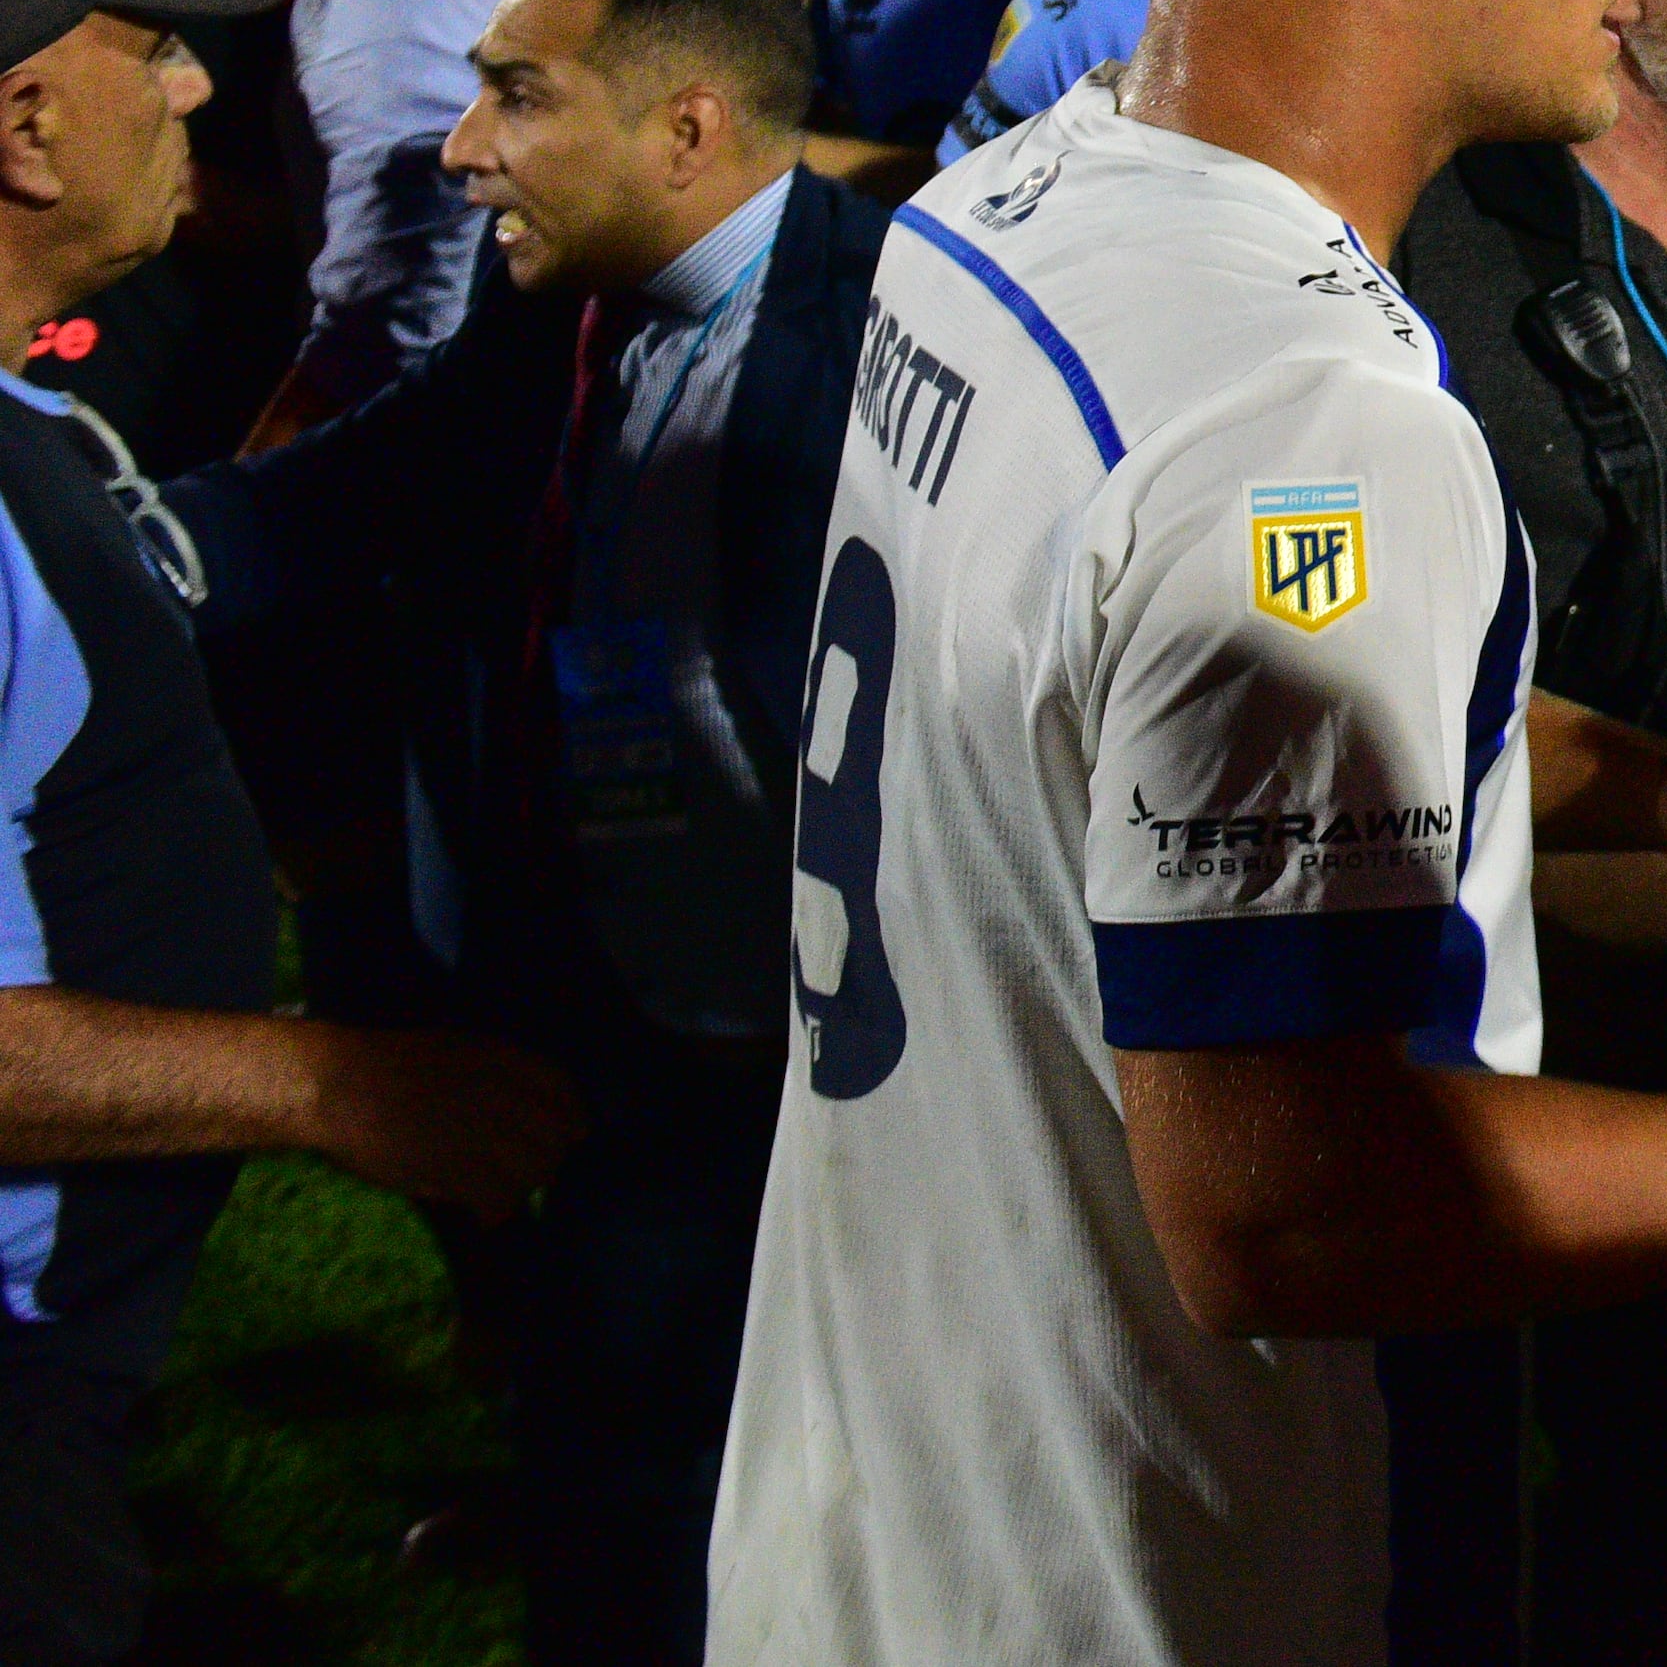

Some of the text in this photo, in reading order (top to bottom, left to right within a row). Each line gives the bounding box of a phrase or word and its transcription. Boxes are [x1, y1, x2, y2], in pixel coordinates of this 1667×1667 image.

[1287, 489, 1324, 506] AFA
[1149, 804, 1453, 852] TERRAWIND
[1156, 852, 1278, 880] GLOBAL
